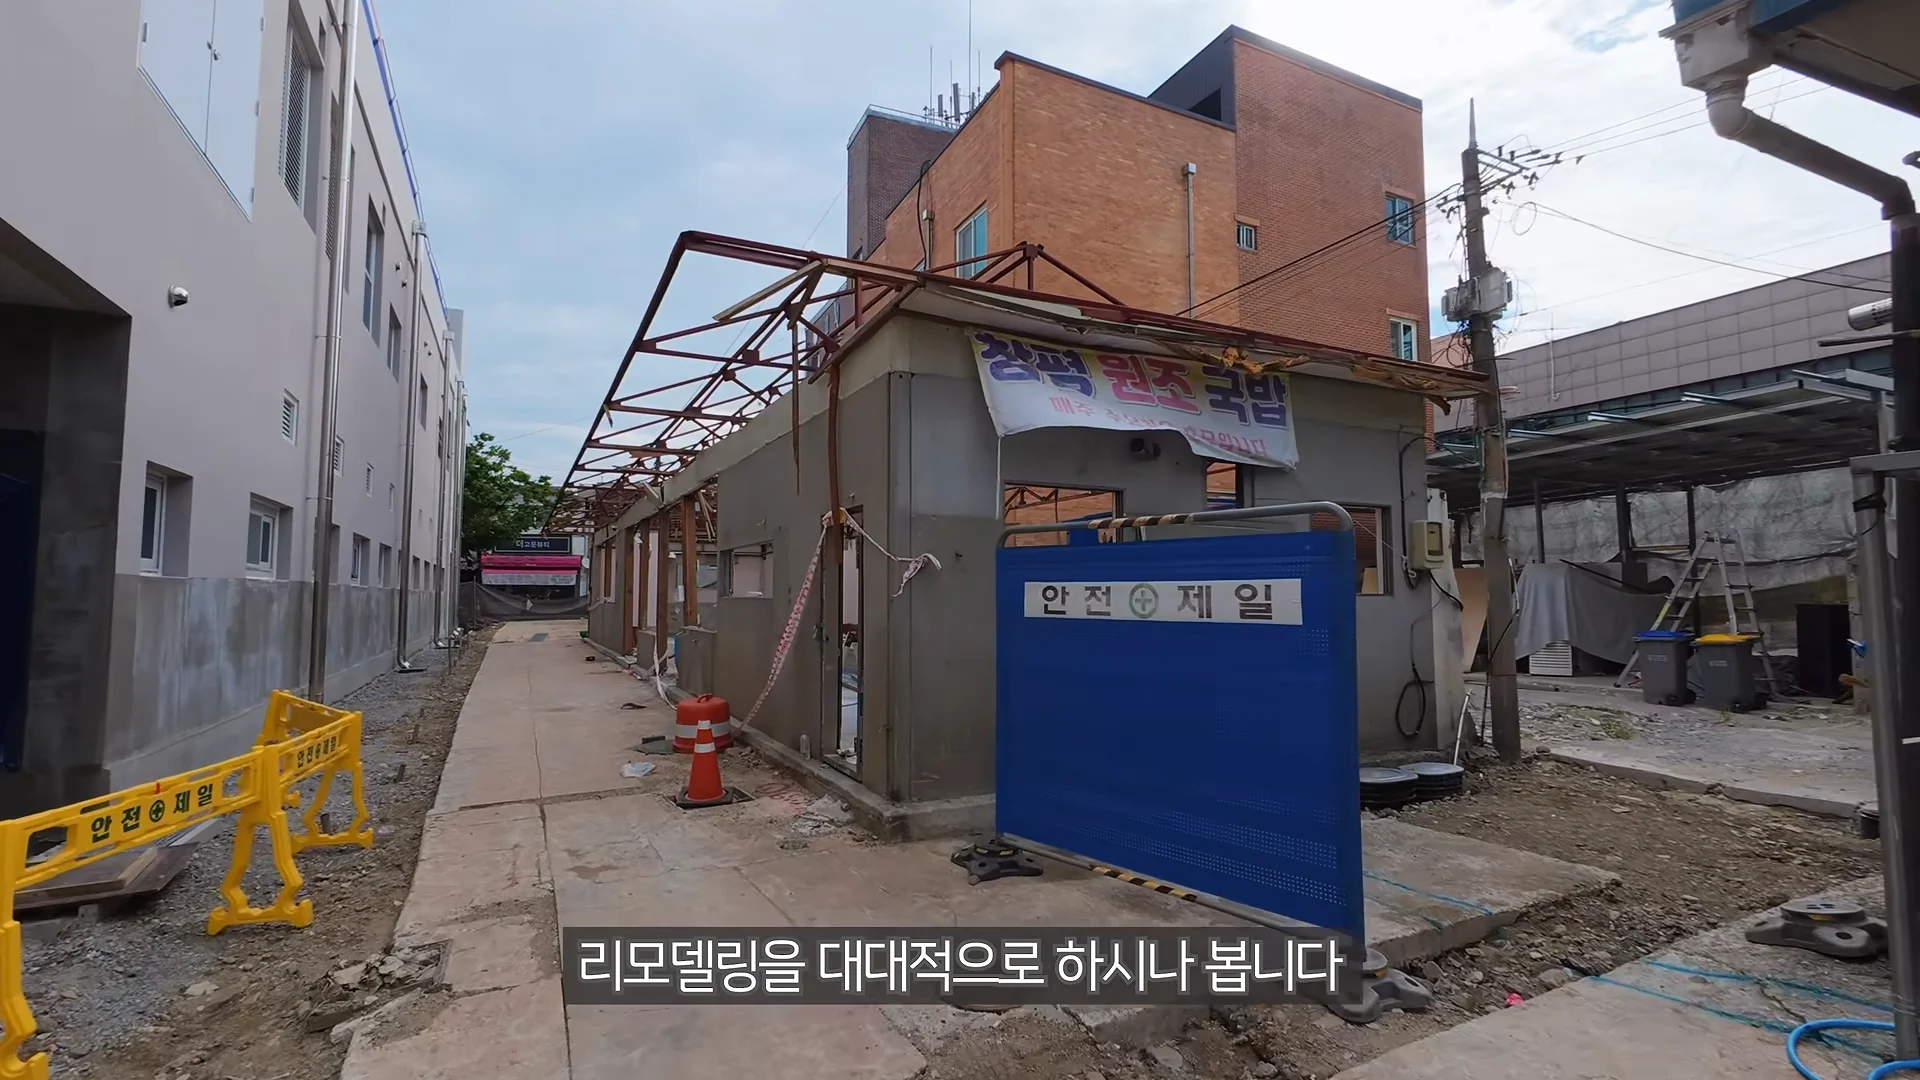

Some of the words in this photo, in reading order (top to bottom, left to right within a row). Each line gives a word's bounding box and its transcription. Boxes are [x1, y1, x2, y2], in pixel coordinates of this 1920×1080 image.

[974, 332, 1097, 398] 창평
[1096, 354, 1201, 415] 원조
[1202, 364, 1288, 429] 국밥
[1049, 396, 1096, 417] 매주
[1041, 585, 1112, 616] 안전
[1177, 583, 1273, 620] 제일
[91, 805, 141, 843] 안전
[173, 783, 213, 814] 제일
